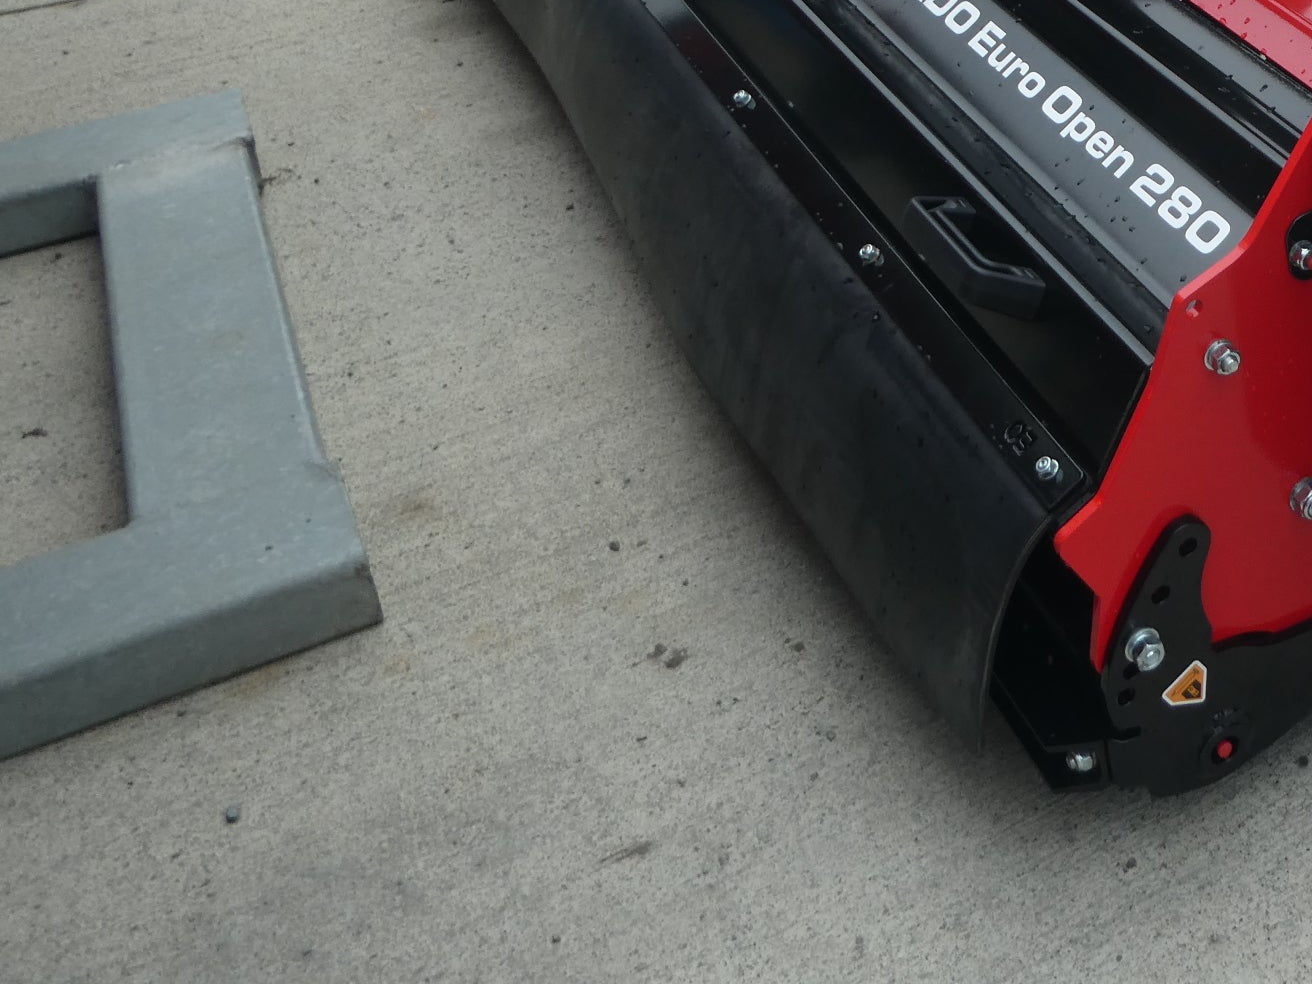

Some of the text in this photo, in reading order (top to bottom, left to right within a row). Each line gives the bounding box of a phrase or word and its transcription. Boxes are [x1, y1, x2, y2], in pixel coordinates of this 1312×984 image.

[967, 20, 1046, 99] Euro
[1041, 85, 1135, 179] Open
[1128, 163, 1231, 255] 280
